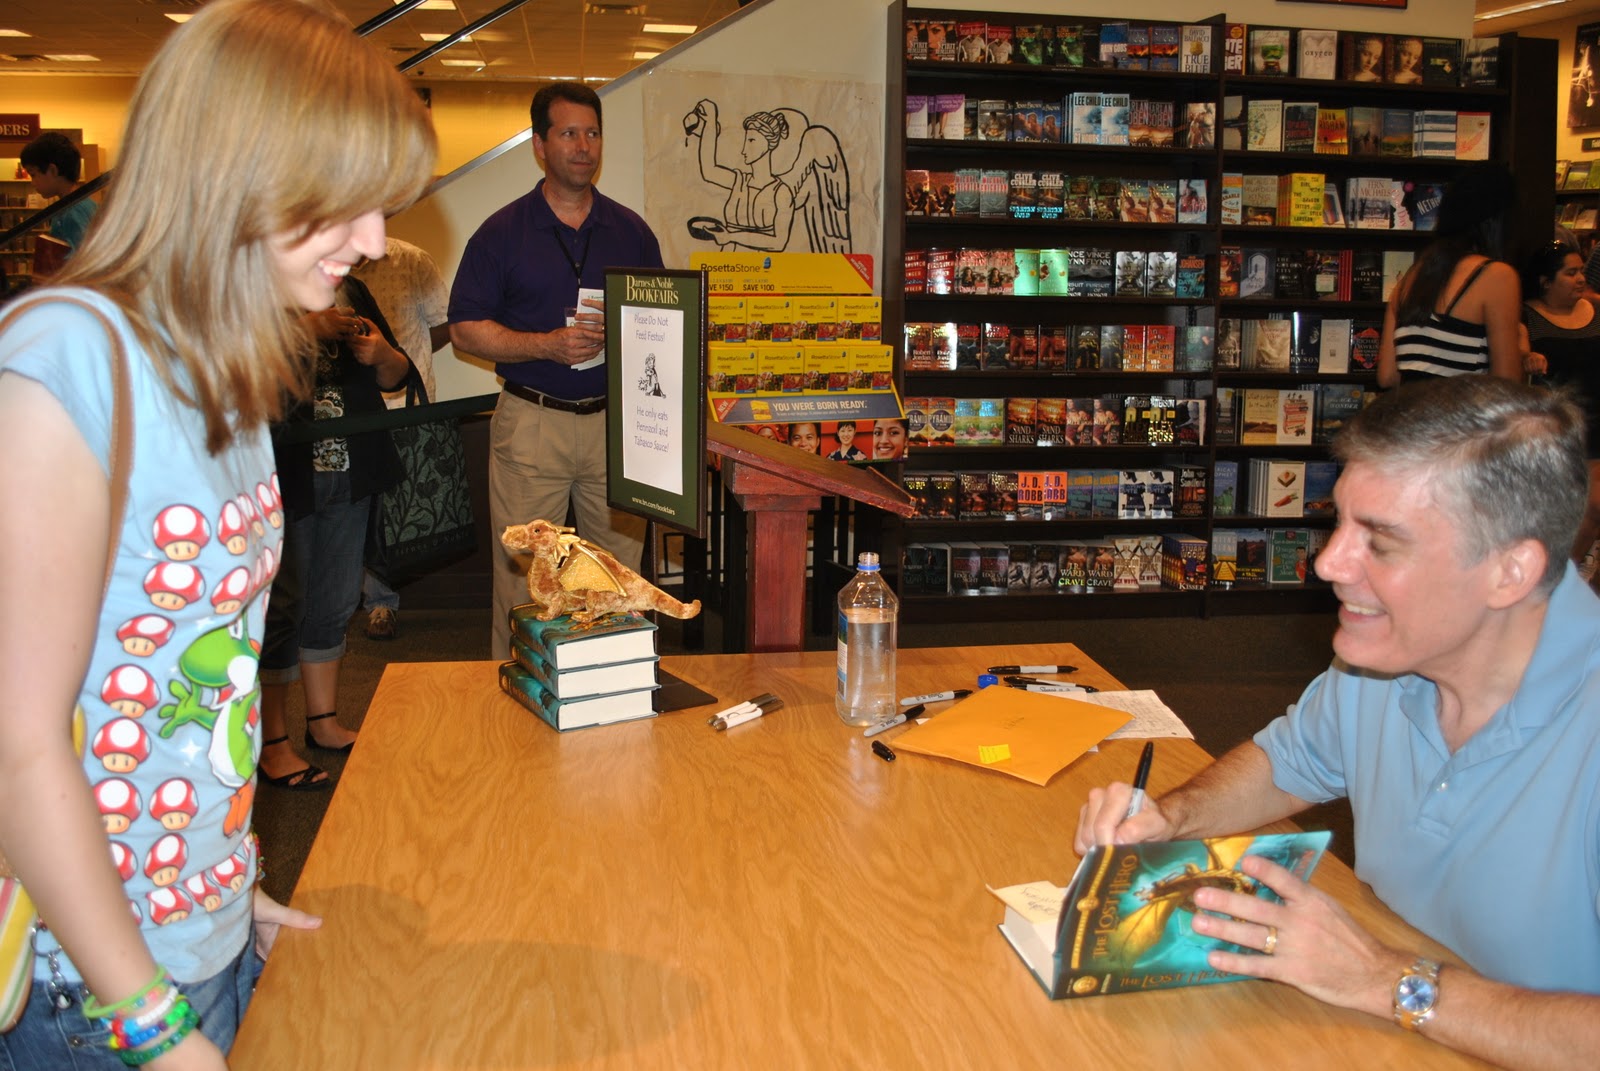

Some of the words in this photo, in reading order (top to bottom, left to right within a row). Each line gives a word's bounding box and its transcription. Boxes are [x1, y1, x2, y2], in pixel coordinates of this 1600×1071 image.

[1225, 39, 1243, 53] ITE
[1305, 50, 1333, 58] oxygen
[1184, 55, 1209, 64] TRUE
[1074, 96, 1085, 106] LEE
[1102, 97, 1112, 107] LEE
[1368, 180, 1384, 188] FERN
[1361, 188, 1390, 197] MICHAELS
[650, 279, 656, 288] &
[656, 276, 674, 289] Noble
[626, 283, 679, 305] BOOKFAIRS
[634, 312, 647, 325] Please
[648, 316, 656, 325] Do
[657, 316, 668, 326] Not
[636, 330, 646, 340] Feed
[773, 402, 790, 412] YOU
[791, 402, 815, 411] WERE
[816, 401, 838, 410] BORN
[636, 405, 644, 416] He
[645, 408, 657, 421] only
[658, 411, 668, 421] eats
[636, 421, 658, 434] Pennzoil
[659, 427, 668, 437] and
[1013, 425, 1031, 434] SAND
[1042, 425, 1060, 434] SAND
[1148, 421, 1173, 432] ALEX
[1008, 434, 1035, 443] SHARKS
[1038, 434, 1064, 443] SHARKS
[1148, 432, 1174, 442] CROSS
[634, 435, 653, 450] Tabasco
[653, 440, 670, 453] Sauce!
[1021, 476, 1029, 488] J.
[1032, 477, 1041, 488] D.
[1044, 475, 1052, 487] J.
[1054, 476, 1063, 487] D.
[964, 483, 987, 492] ROBARDS
[994, 483, 1018, 492] ROBARDS
[1018, 489, 1042, 501] ROBB
[1060, 569, 1085, 577] WARD
[1058, 578, 1084, 586] CRAVE
[1109, 854, 1137, 895] HERO
[1094, 898, 1119, 935] LOST
[1093, 936, 1108, 959] THE
[1120, 978, 1140, 987] THE
[1141, 973, 1186, 988] LOST
